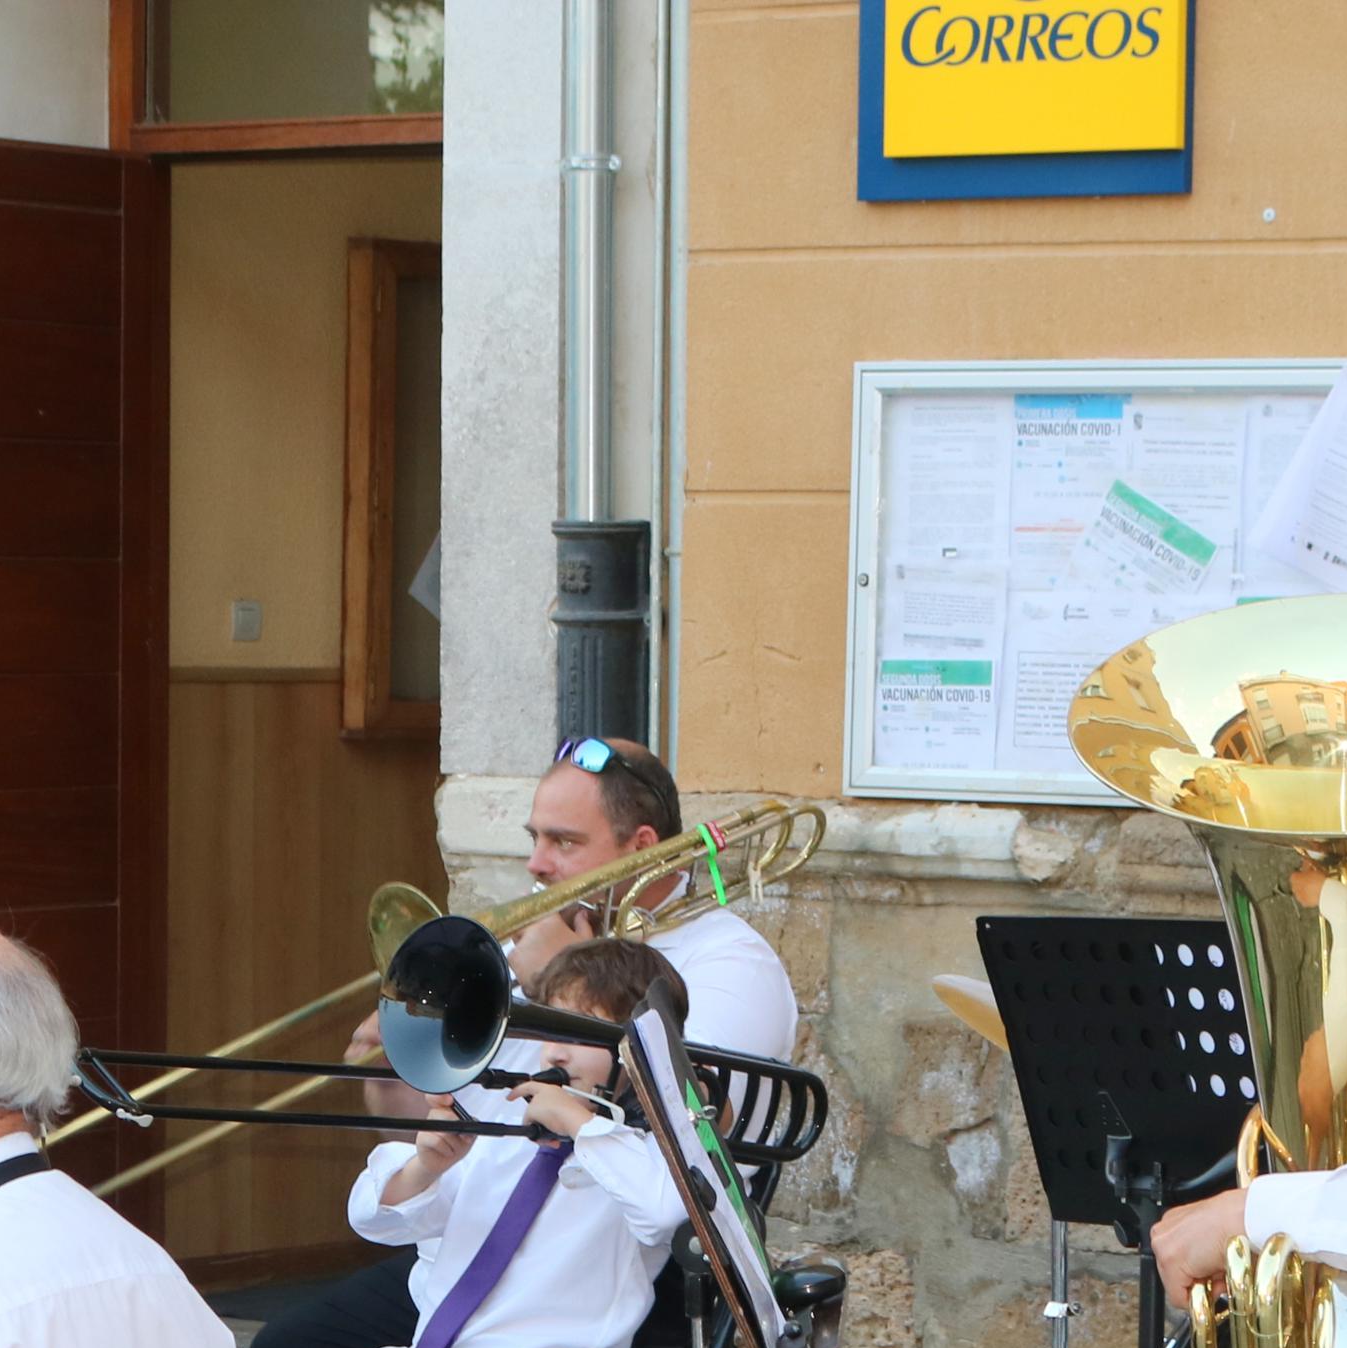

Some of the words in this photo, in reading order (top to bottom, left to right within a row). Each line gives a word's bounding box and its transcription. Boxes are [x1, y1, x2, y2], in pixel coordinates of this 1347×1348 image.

[901, 6, 1162, 67] CORREOS
[1017, 419, 1078, 437] VACUNACIÓN
[1100, 505, 1156, 551] VACUNACIÓN
[1154, 543, 1201, 581] COVID-19
[881, 685, 944, 701] VACUNACIÓN
[945, 688, 991, 703] COVID-19
